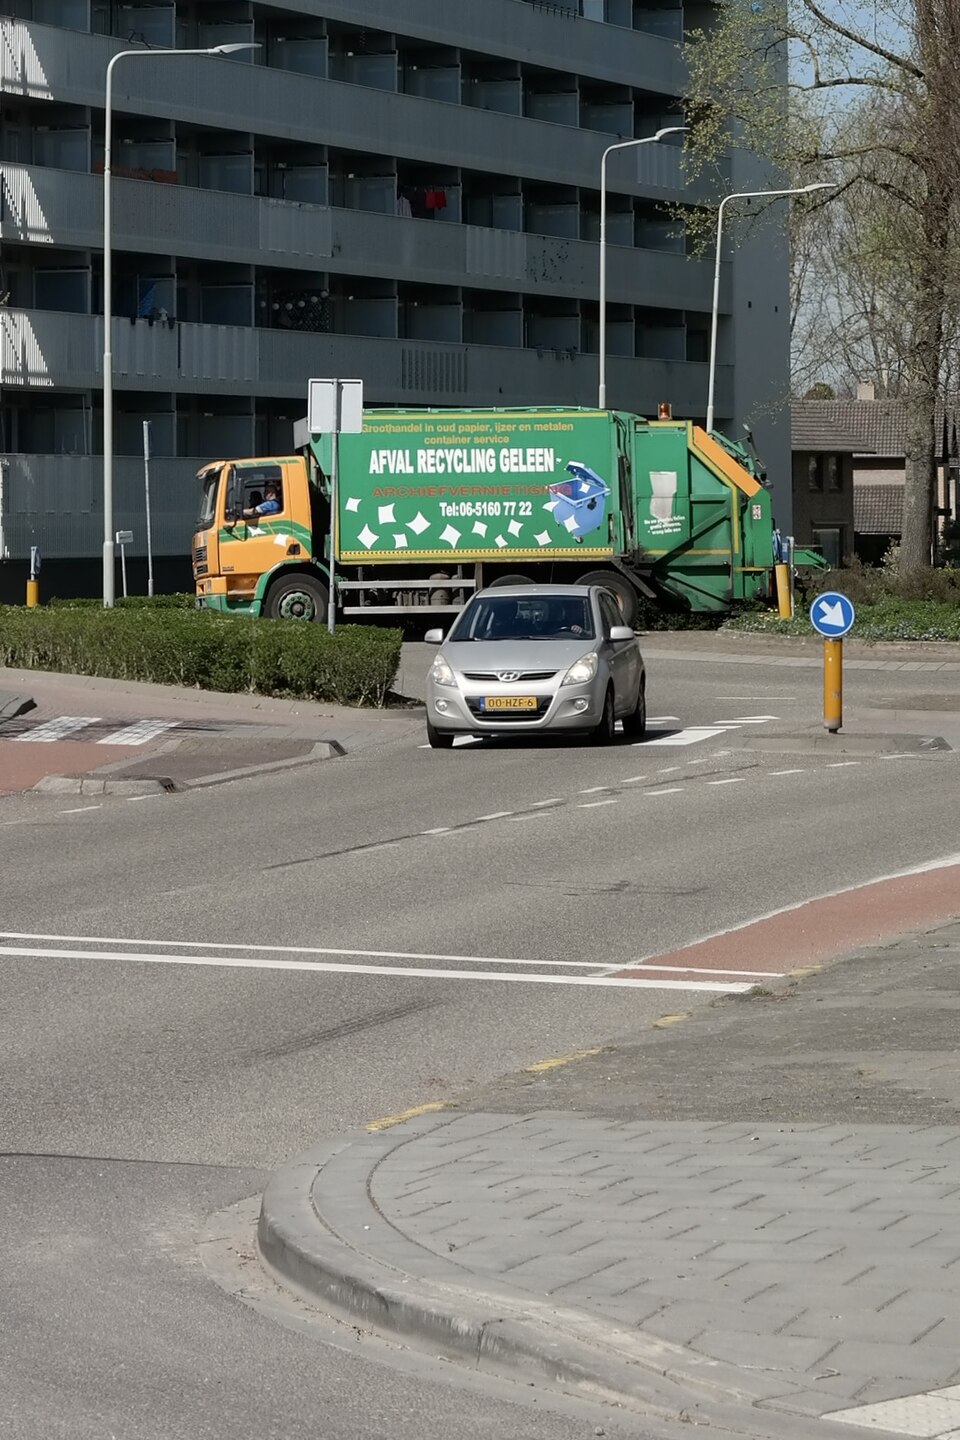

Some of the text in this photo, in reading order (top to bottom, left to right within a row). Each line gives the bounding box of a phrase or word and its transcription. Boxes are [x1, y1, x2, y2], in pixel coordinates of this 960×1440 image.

[362, 422, 574, 434] Groothandel in oud papier, ijzer en metalen
[424, 435, 510, 445] container service
[369, 447, 555, 474] AFVAL RECYCLING GELEEN
[372, 484, 573, 497] ARCHIEFVERNIETIGING
[503, 501, 517, 516] 77
[519, 501, 533, 516] 22
